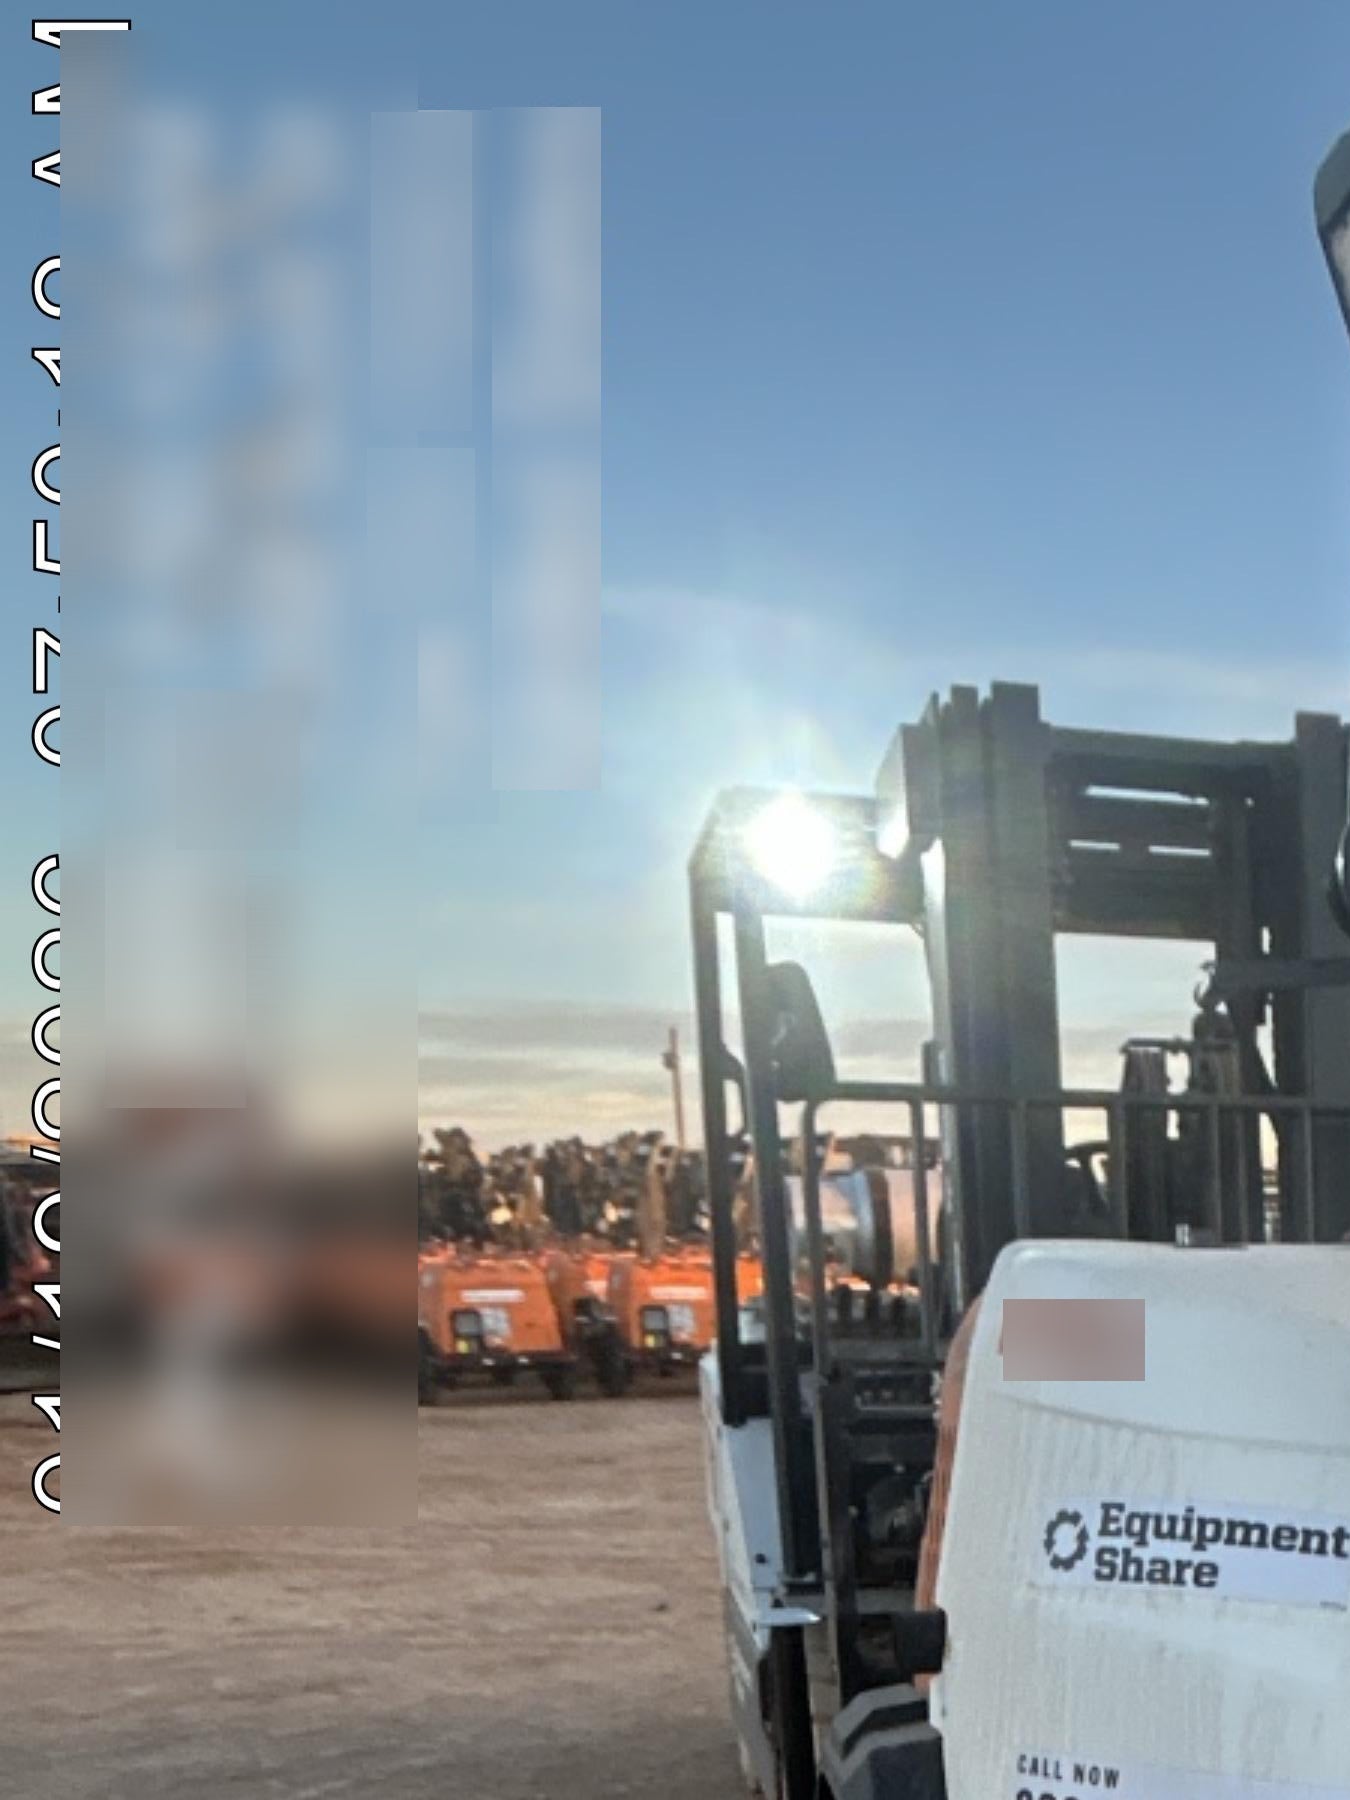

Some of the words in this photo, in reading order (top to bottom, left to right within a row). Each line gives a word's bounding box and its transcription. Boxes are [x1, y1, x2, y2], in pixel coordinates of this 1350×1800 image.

[1094, 1546, 1220, 1589] Share
[1016, 1754, 1064, 1781] CALL
[1073, 1763, 1121, 1789] NOW
